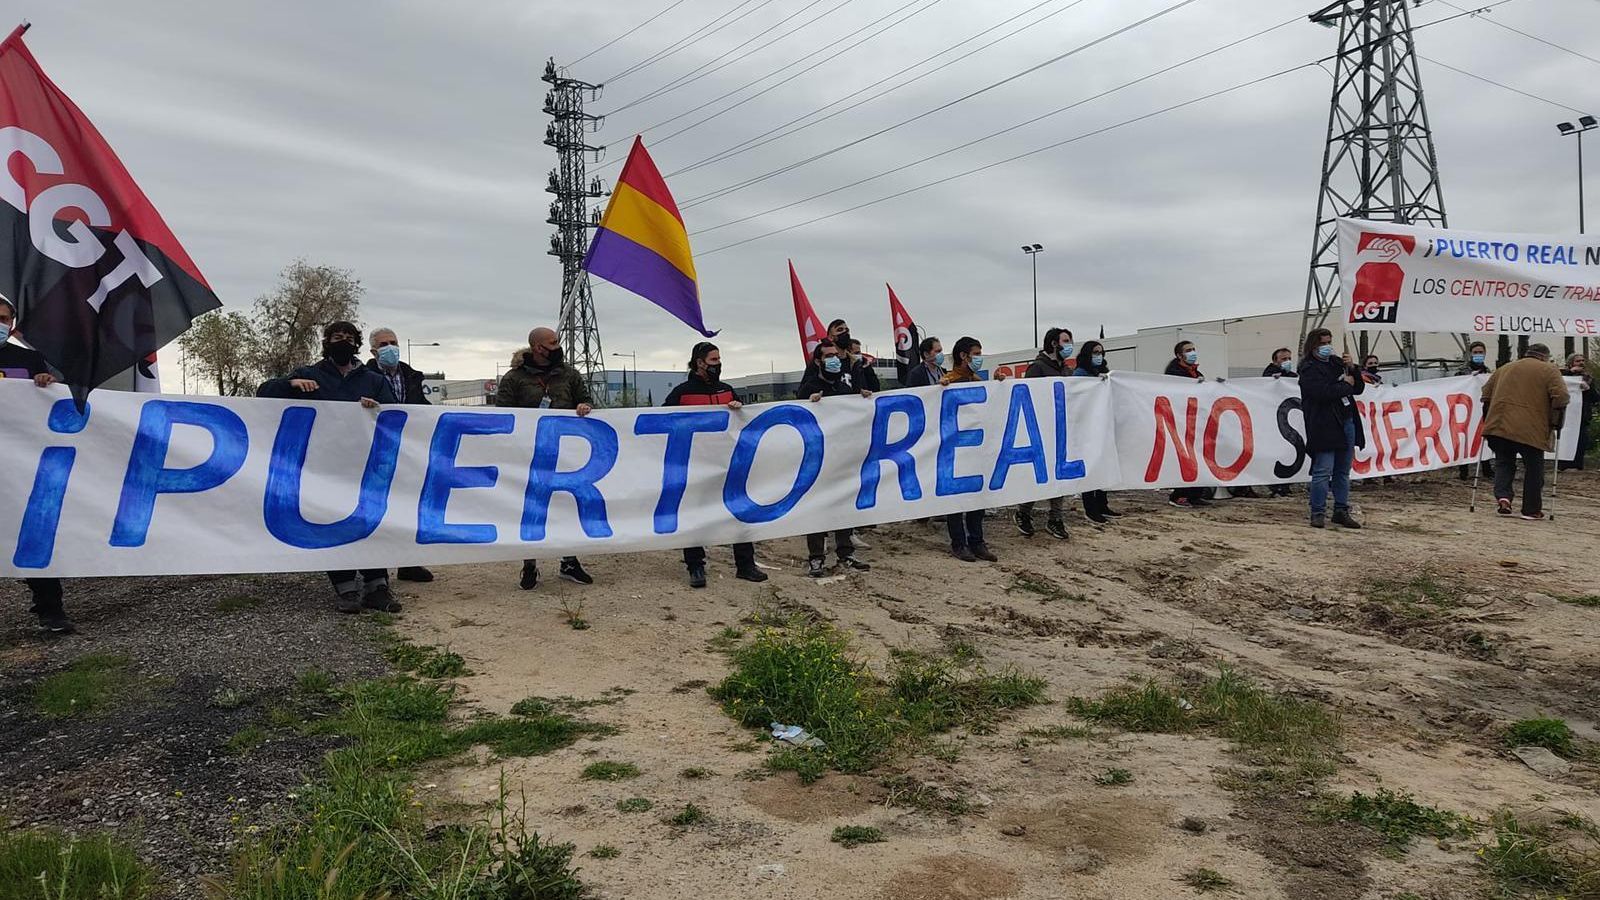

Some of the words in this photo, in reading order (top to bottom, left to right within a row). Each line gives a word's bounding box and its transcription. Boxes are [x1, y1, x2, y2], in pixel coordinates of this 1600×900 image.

[0, 126, 163, 313] CGT
[1423, 239, 1519, 262] ¡PUERTO
[1527, 244, 1578, 265] REAL
[1413, 278, 1446, 295] LOS
[1450, 280, 1531, 298] CENTROS
[1534, 284, 1560, 299] DE
[1353, 301, 1396, 320] CGT
[1474, 315, 1495, 332] SE
[1500, 316, 1556, 333] LUCHA
[1559, 318, 1569, 333] Y
[1575, 318, 1597, 334] SE
[856, 380, 1086, 510] REAL
[1144, 395, 1254, 483] NO
